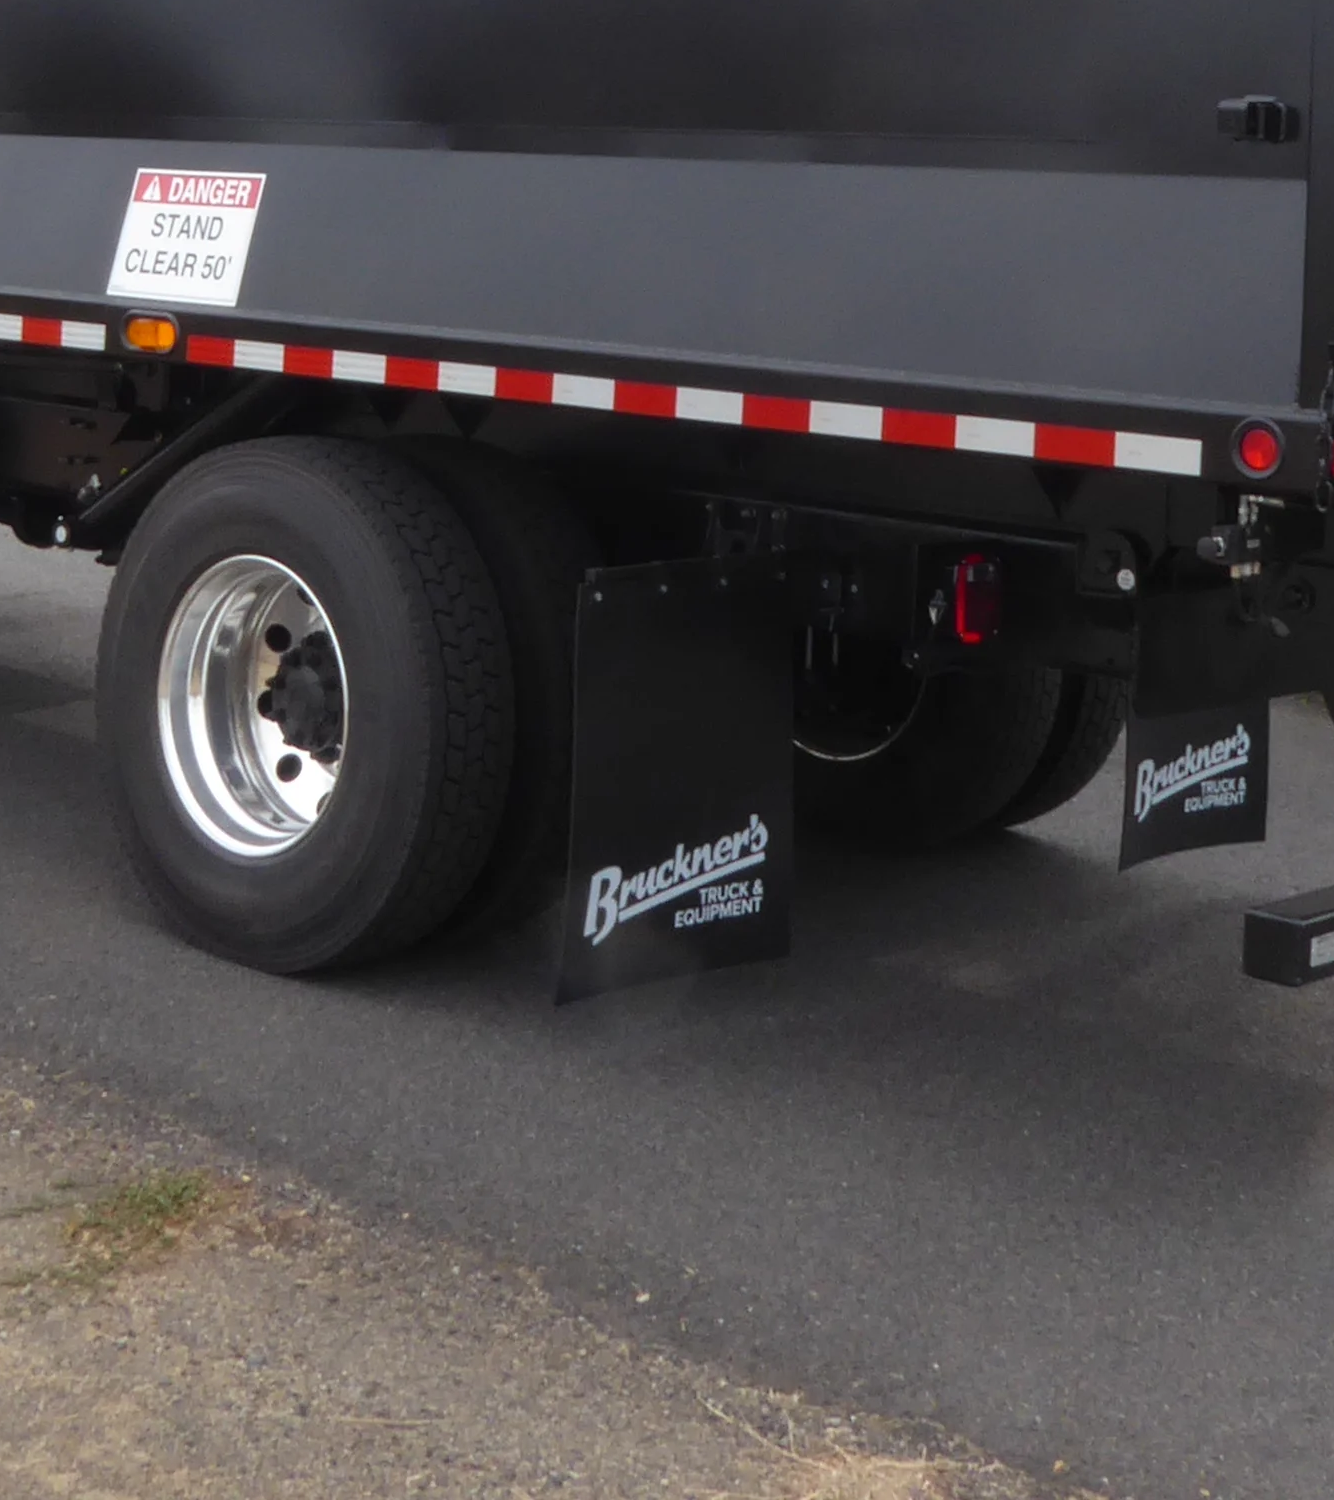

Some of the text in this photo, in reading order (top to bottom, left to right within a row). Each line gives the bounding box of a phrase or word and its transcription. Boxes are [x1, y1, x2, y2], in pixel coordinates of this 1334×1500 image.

[168, 176, 252, 206] DANGER
[151, 213, 224, 241] STAND
[125, 248, 233, 281] CLEAR 50'
[1133, 723, 1251, 823] Bruckner's
[1201, 778, 1235, 795] TRUCK
[1184, 791, 1246, 813] EQUIPMENT
[583, 813, 769, 946] Bruckner's
[699, 878, 764, 905] TRUCK &
[674, 896, 763, 928] EQUIPMENT
